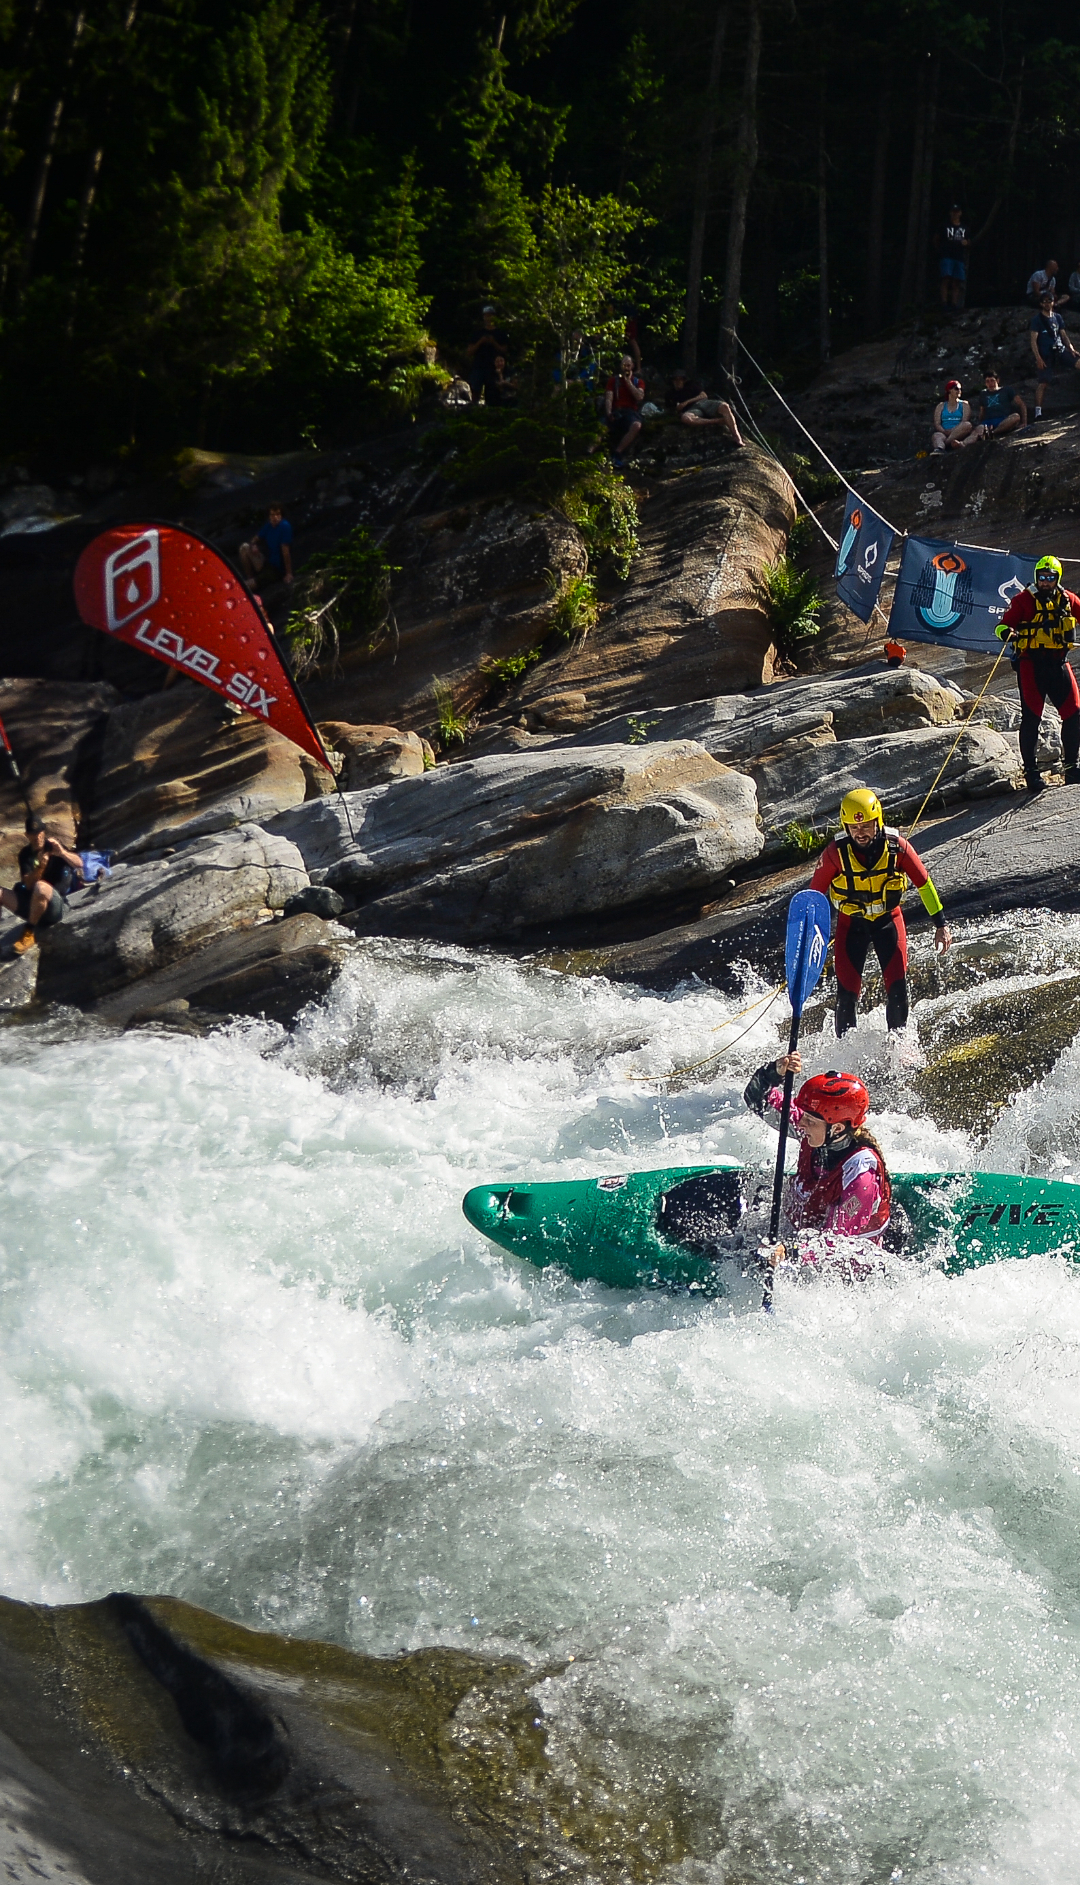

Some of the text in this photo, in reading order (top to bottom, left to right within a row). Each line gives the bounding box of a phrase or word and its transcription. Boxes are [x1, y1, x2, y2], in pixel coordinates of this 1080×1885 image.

[135, 619, 278, 718] LEVEL SIX
[962, 1203, 1065, 1227] FIVE
